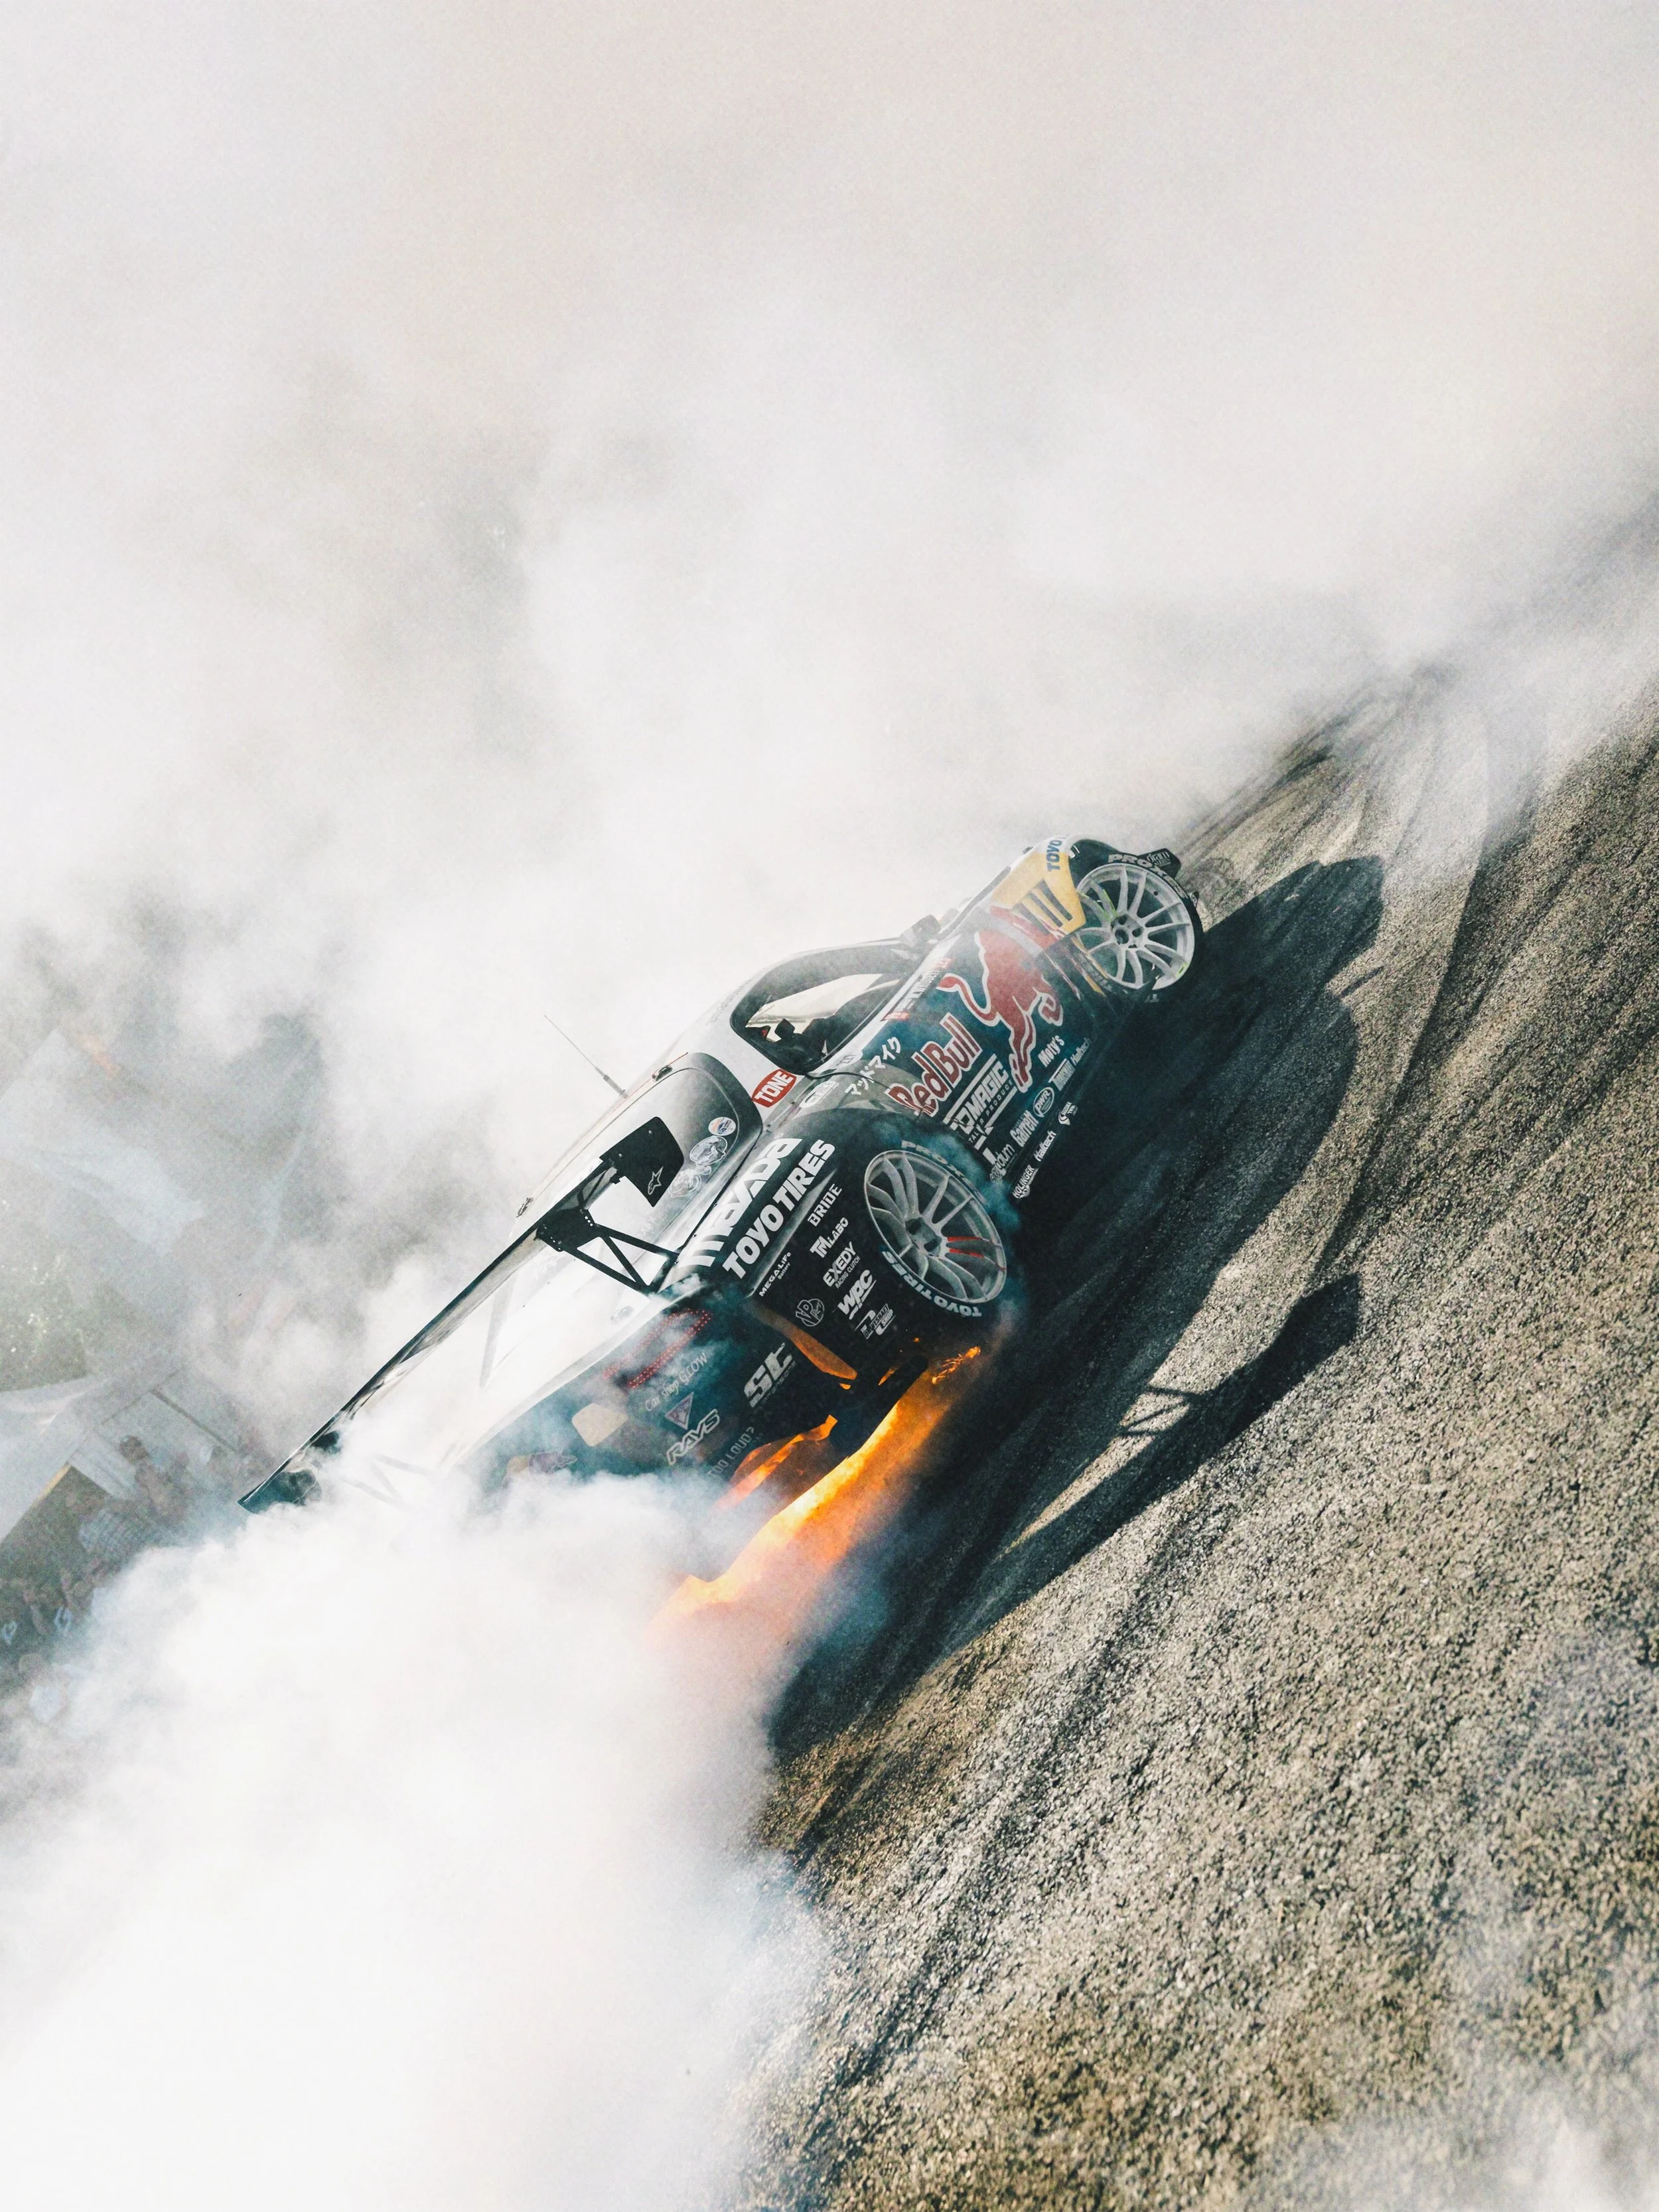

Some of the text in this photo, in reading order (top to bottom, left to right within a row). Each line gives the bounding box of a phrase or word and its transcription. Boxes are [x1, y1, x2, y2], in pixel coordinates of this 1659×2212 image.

[1046, 838, 1062, 871] TOYO
[845, 1035, 902, 1096] マッドマイク
[1037, 1035, 1065, 1067] Moty's
[755, 1071, 793, 1104] TONE
[985, 1079, 1013, 1115] PRODUCE
[1033, 1090, 1050, 1116] PWR
[1009, 1109, 1039, 1147] Garrett
[1033, 1129, 1056, 1161] Haltech
[1011, 1165, 1035, 1197] HOLINGER
[722, 1205, 786, 1278] TOYO
[774, 1139, 835, 1211] TIRES
[807, 1183, 842, 1226] BRIDE
[776, 1262, 790, 1280] Battery
[822, 1242, 857, 1286] EXEDY
[834, 1255, 860, 1288] RACING CLUTCH
[881, 1250, 982, 1317] TOYO TIRES
[880, 1308, 894, 1327] SHOP
[642, 1395, 662, 1412] Car
[658, 1378, 680, 1399] shop
[677, 1351, 708, 1384] GLOW
[666, 1408, 721, 1464] RAYS
[707, 1457, 729, 1478] TOO
